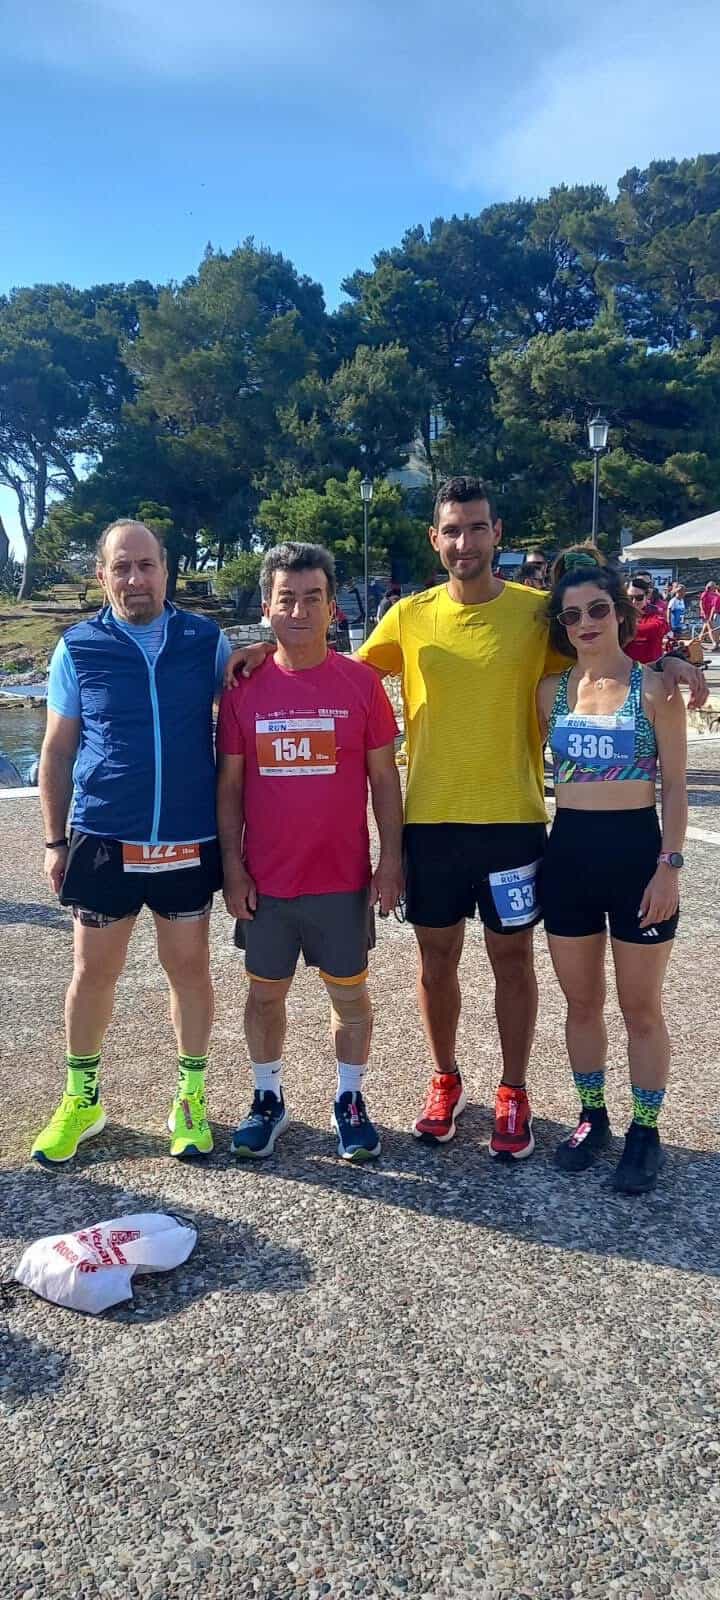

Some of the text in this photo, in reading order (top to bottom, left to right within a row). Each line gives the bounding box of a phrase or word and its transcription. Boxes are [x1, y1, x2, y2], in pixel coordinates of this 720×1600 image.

[567, 719, 587, 727] RUN
[271, 737, 312, 761] 154
[567, 733, 614, 760] 336
[500, 873, 520, 883] RUN
[508, 884, 535, 911] 33
[52, 1239, 79, 1264] Race
